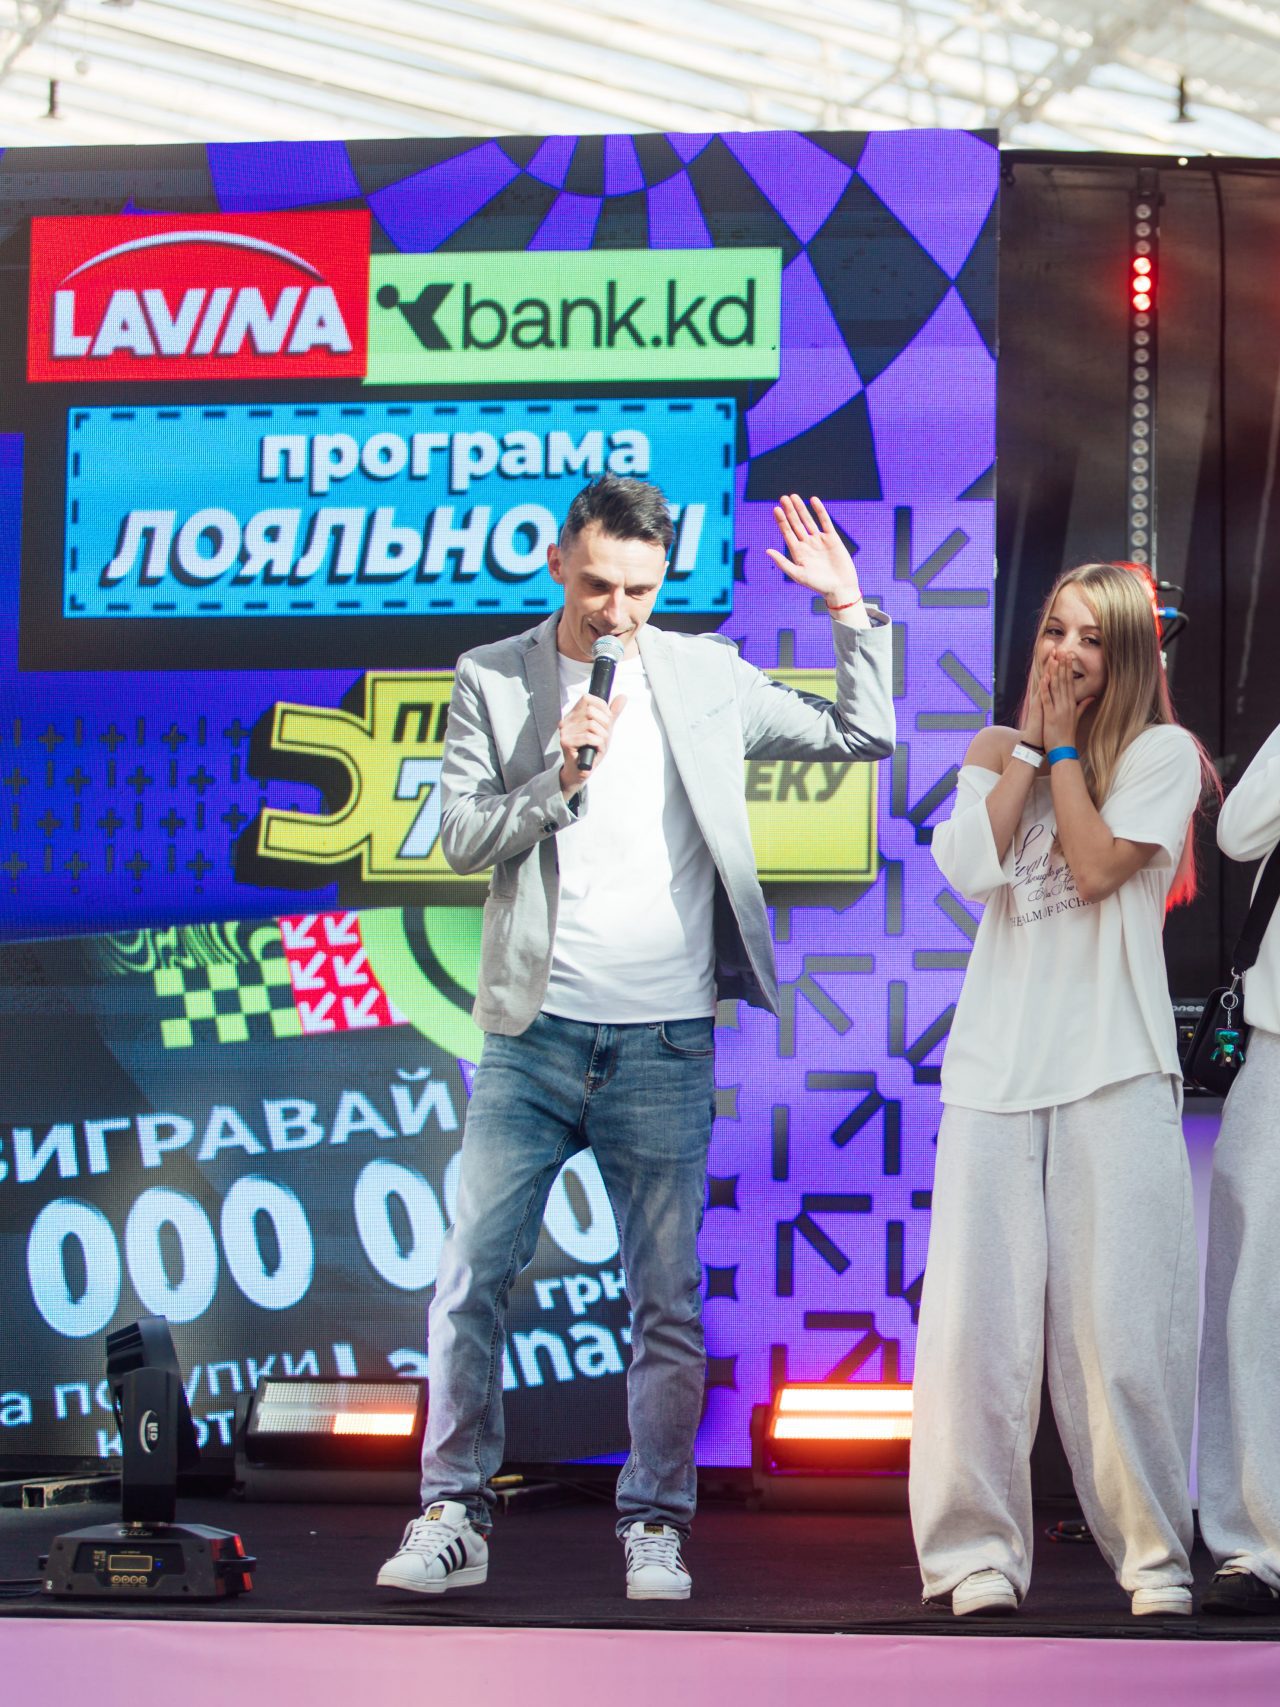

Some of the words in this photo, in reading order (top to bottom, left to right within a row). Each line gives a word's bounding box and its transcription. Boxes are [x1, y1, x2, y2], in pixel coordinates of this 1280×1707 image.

[51, 285, 353, 358] LAVINA
[462, 277, 756, 350] bank.kd
[261, 428, 652, 496] програма
[104, 503, 706, 585] ЛОЯЛЬНОІ
[393, 757, 446, 860] 7
[744, 759, 853, 801] ЕКУ
[0, 1067, 458, 1183] ИГРАВАЙ
[26, 1174, 314, 1339] 000
[352, 1146, 621, 1291] 00
